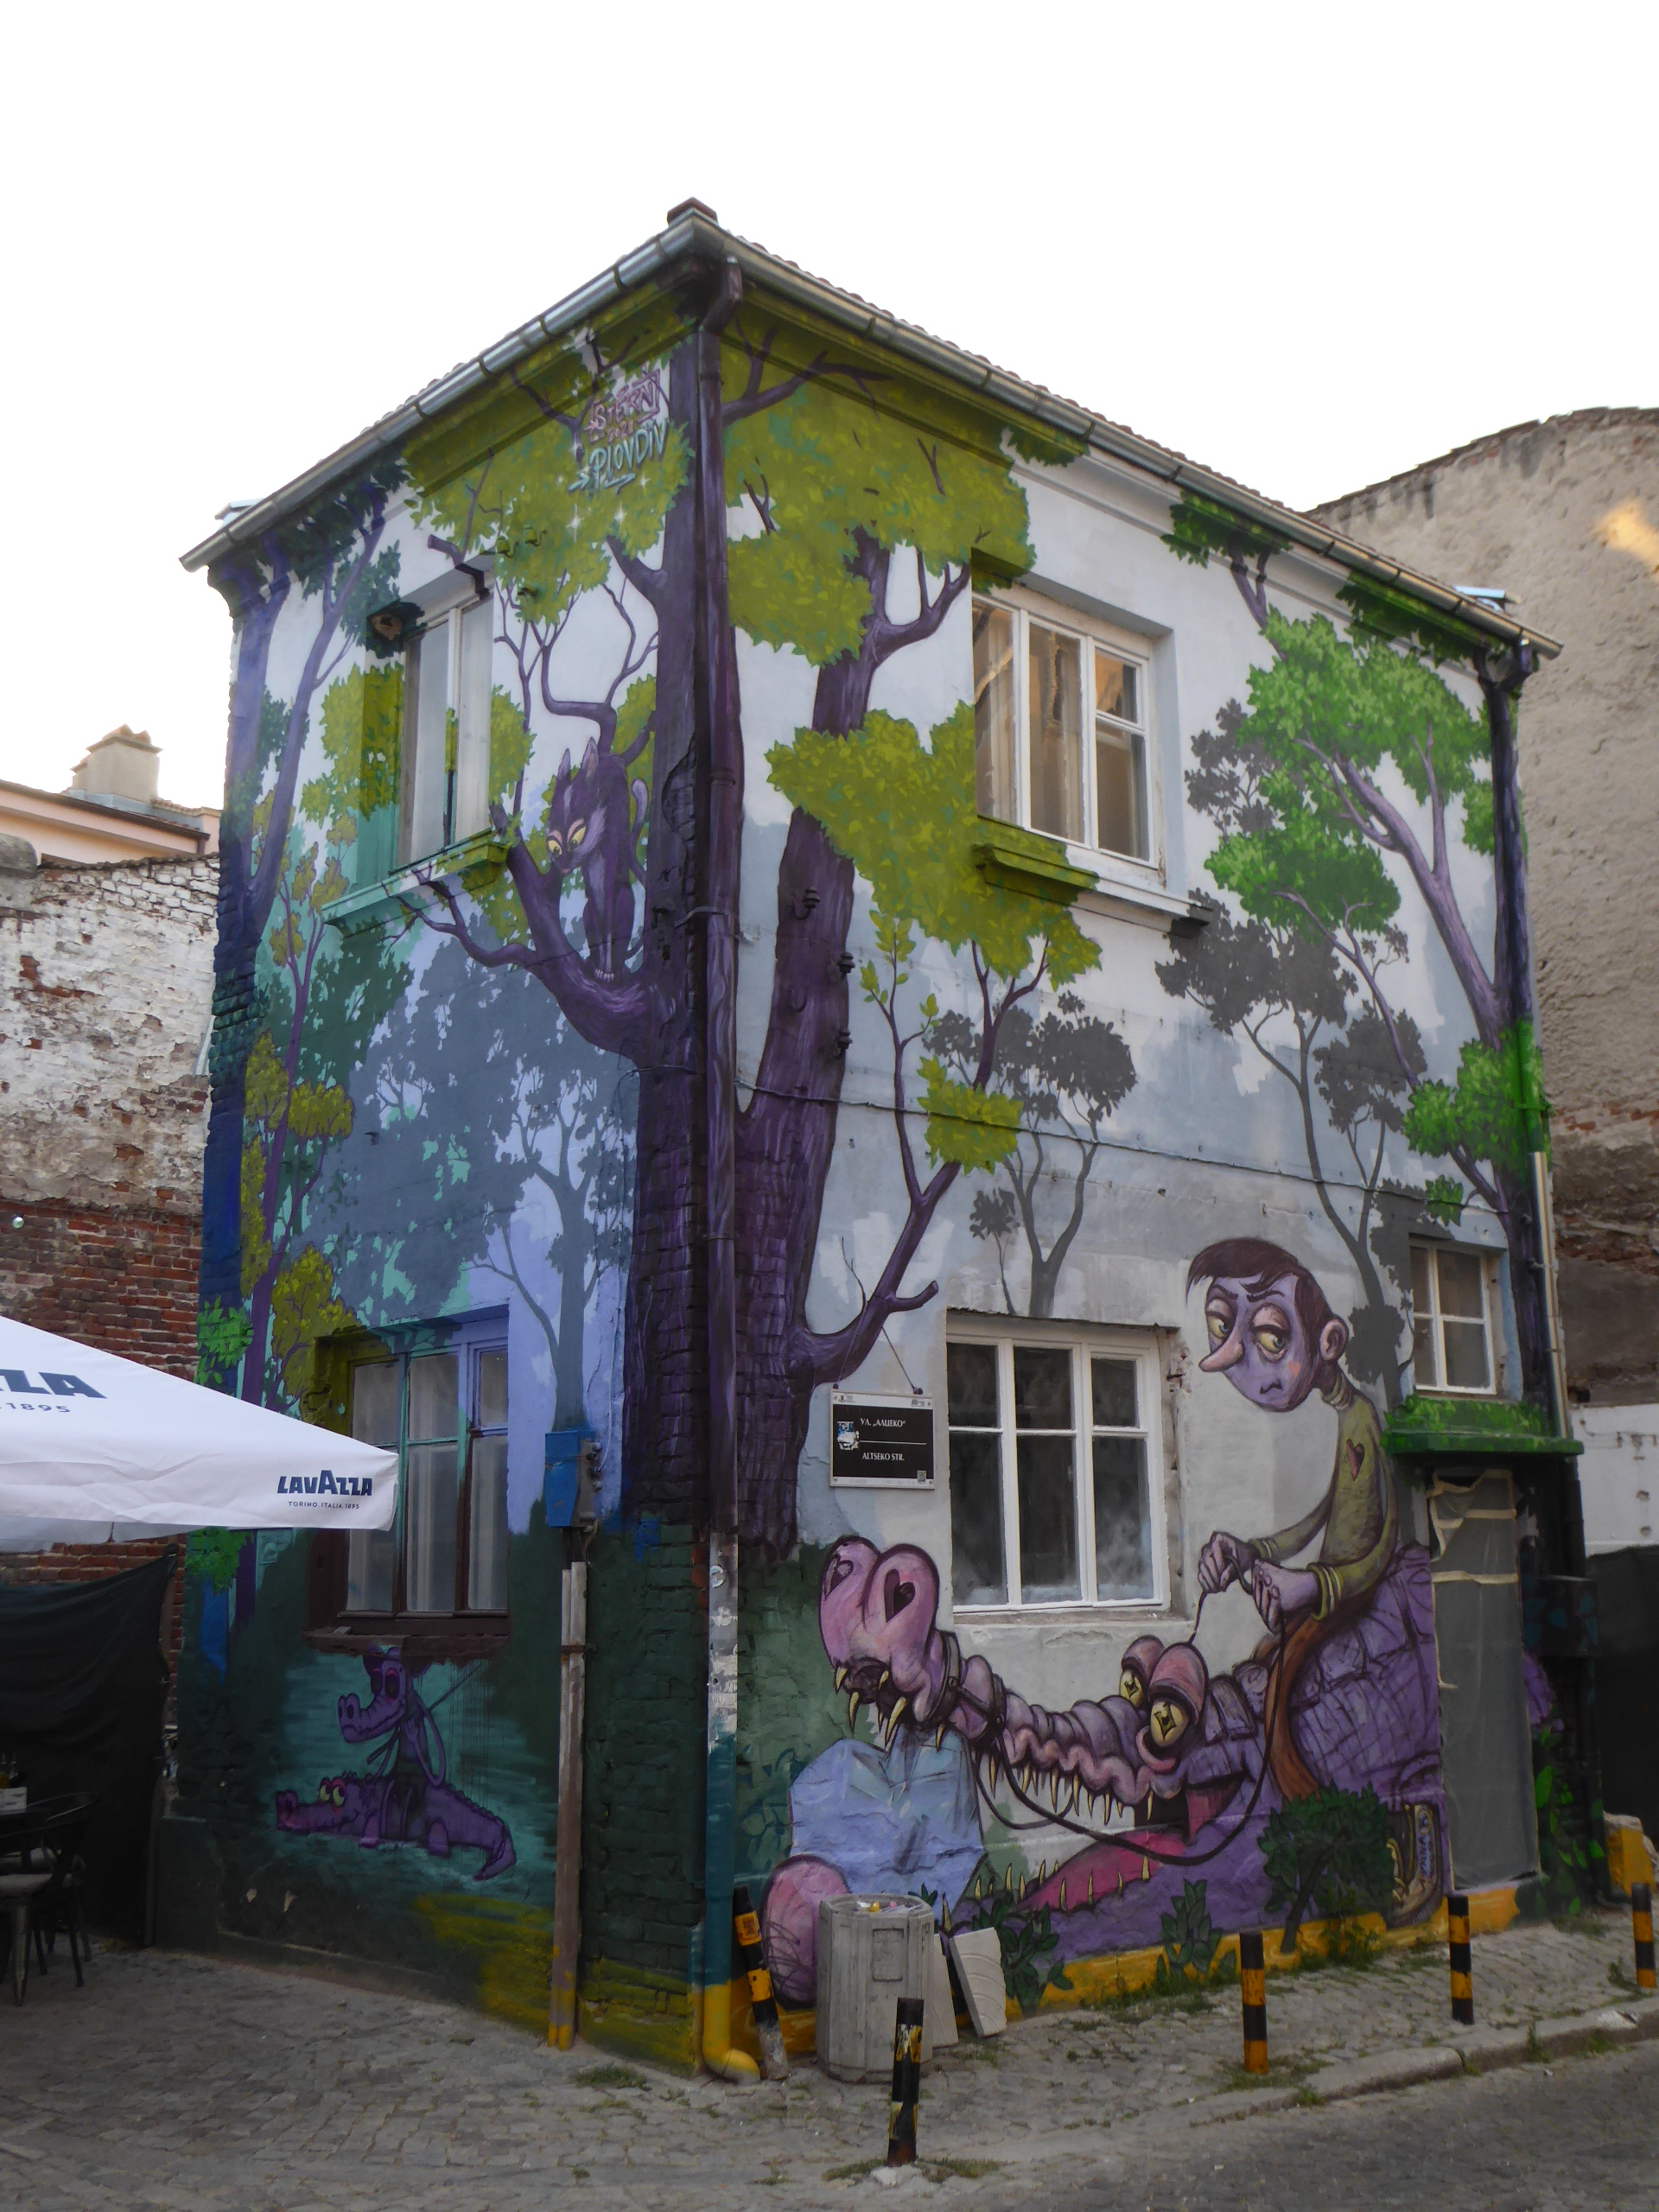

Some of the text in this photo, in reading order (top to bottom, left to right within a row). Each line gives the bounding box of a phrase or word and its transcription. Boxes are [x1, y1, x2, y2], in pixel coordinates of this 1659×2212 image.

[588, 418, 668, 489] PLOVDIV
[6, 1402, 71, 1413] 1895
[861, 1452, 906, 1461] ALTSEKO STR.
[276, 1470, 372, 1496] LAVAZZA
